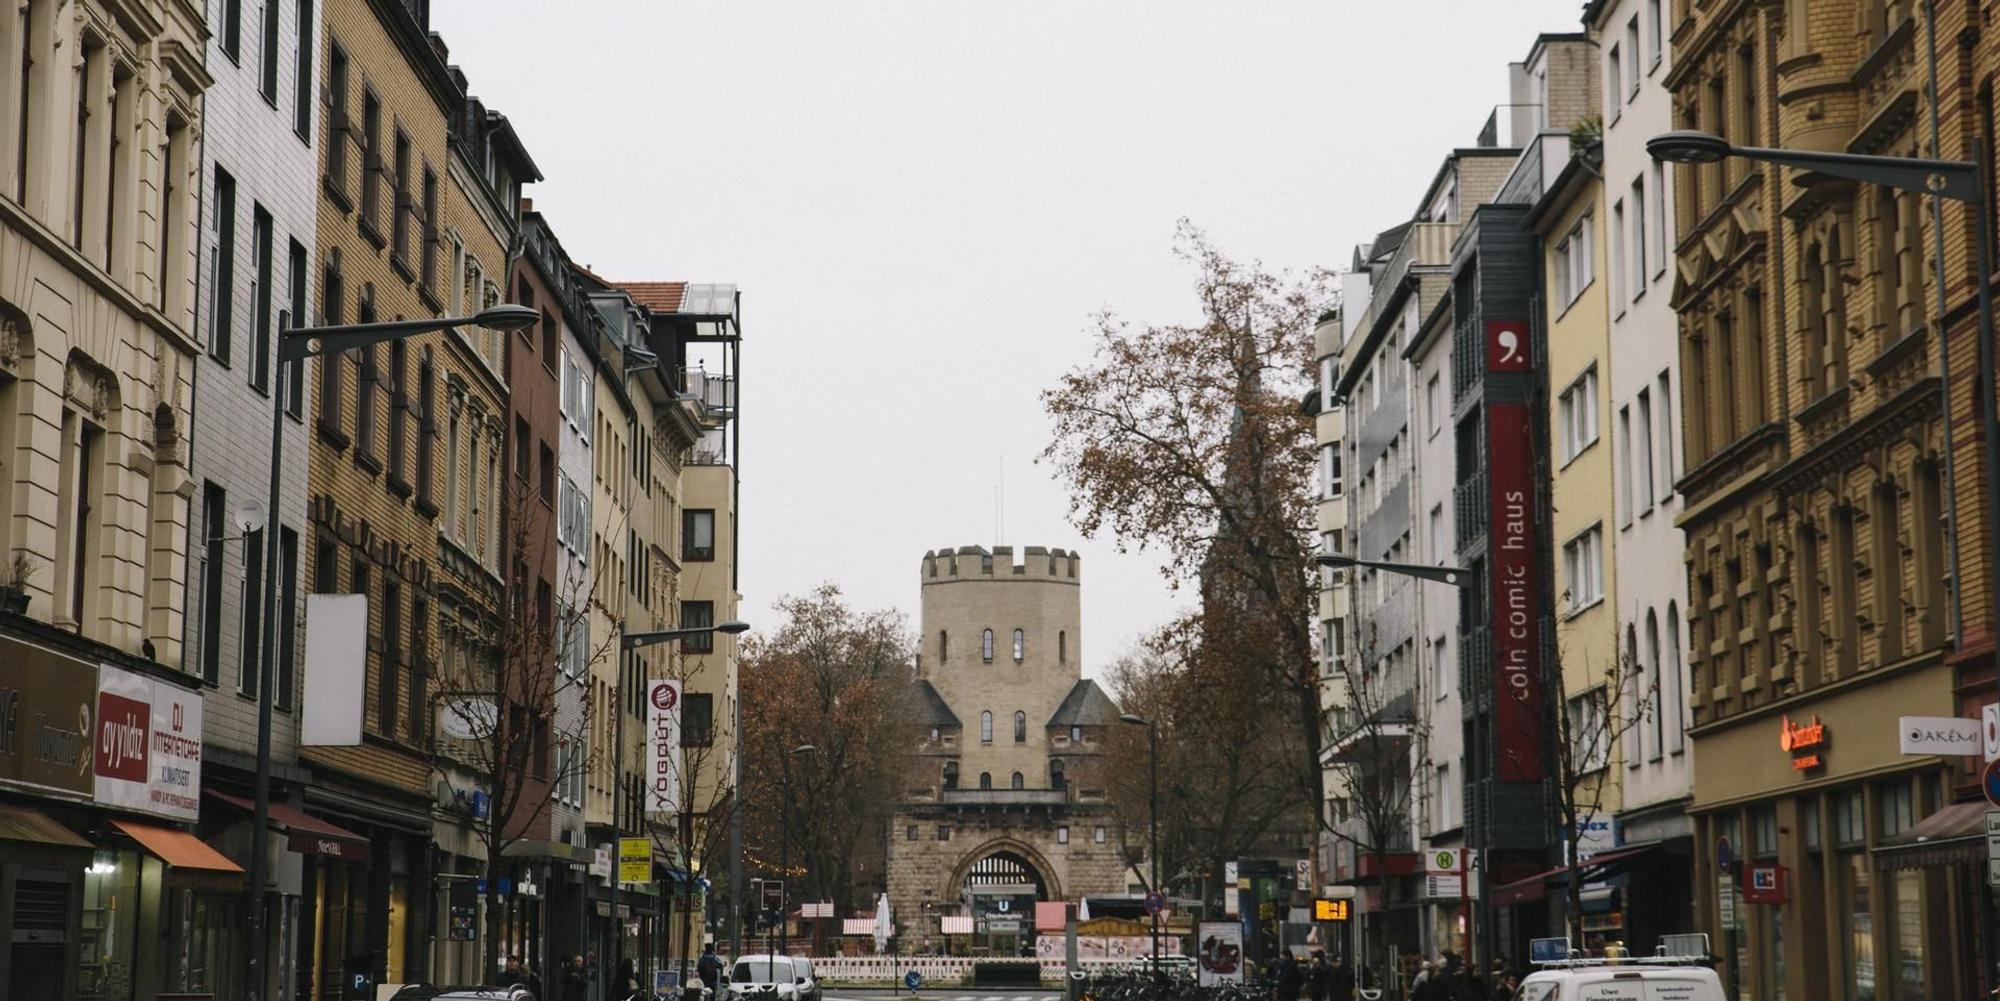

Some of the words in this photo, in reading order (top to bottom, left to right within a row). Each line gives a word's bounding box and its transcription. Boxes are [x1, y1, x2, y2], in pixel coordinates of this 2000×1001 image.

[1501, 490, 1525, 550] haus
[1503, 563, 1528, 638] comic
[172, 702, 184, 733] DJ
[998, 900, 1009, 912] U
[354, 974, 364, 989] P
